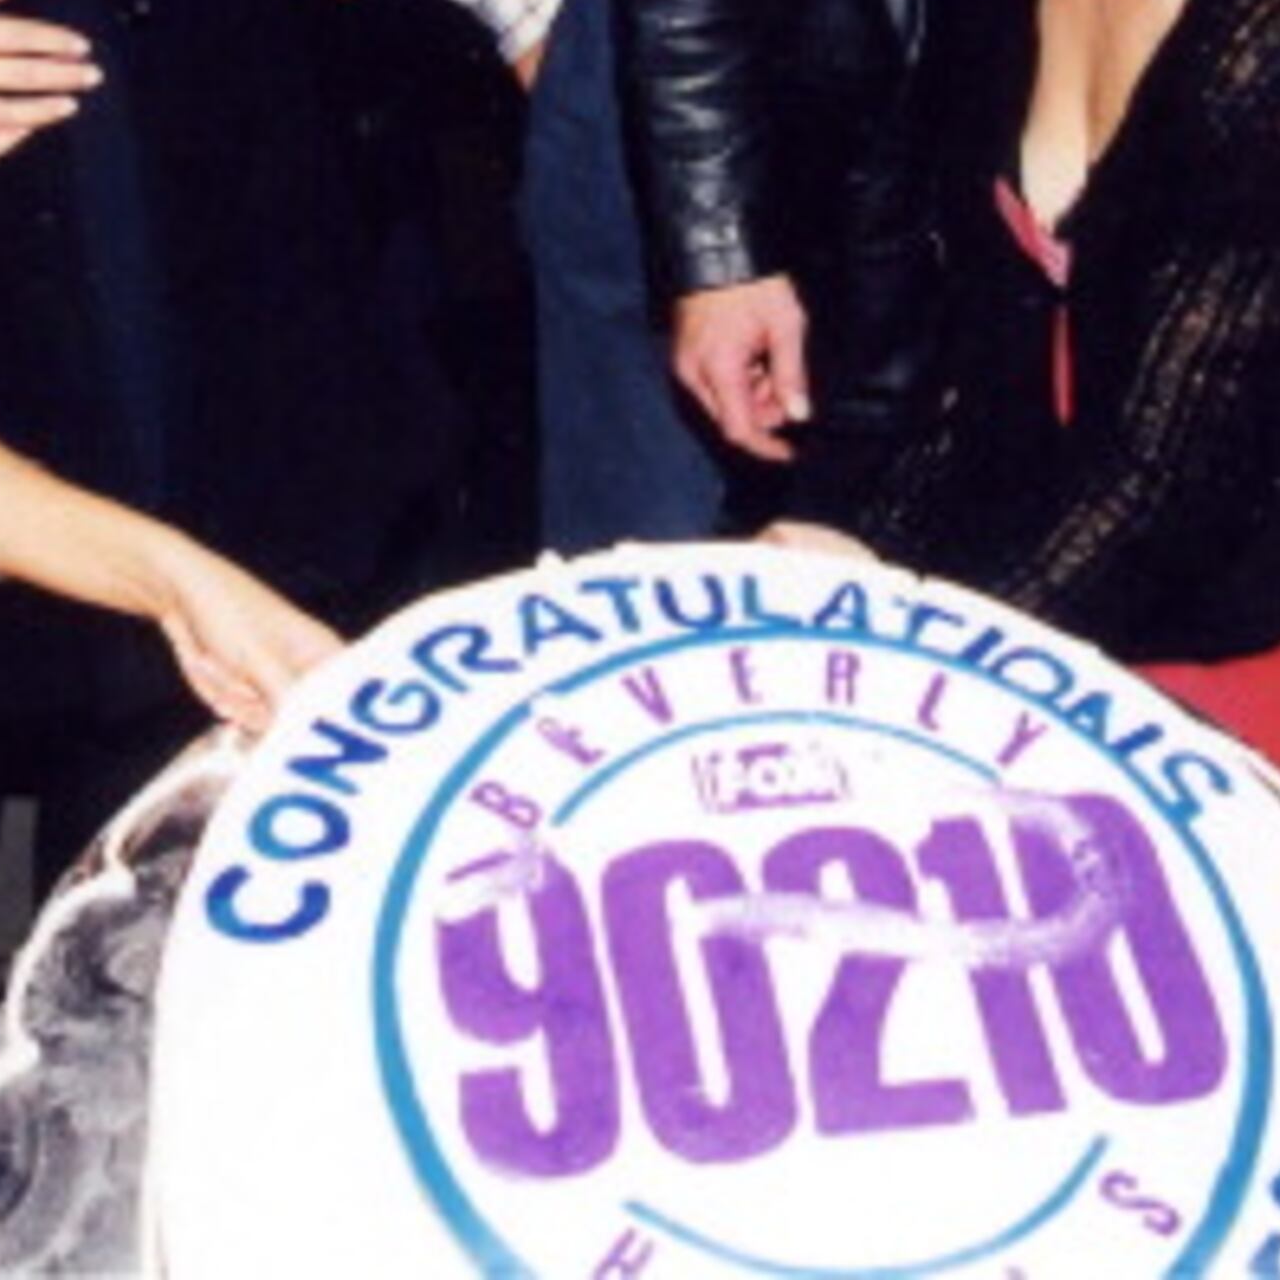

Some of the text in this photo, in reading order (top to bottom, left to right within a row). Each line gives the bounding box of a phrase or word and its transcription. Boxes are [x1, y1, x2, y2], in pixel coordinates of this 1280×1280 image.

[204, 574, 1234, 945] CONGRATULATIONS
[469, 645, 1048, 831] BEVERLY
[434, 792, 1230, 1181] 90210
